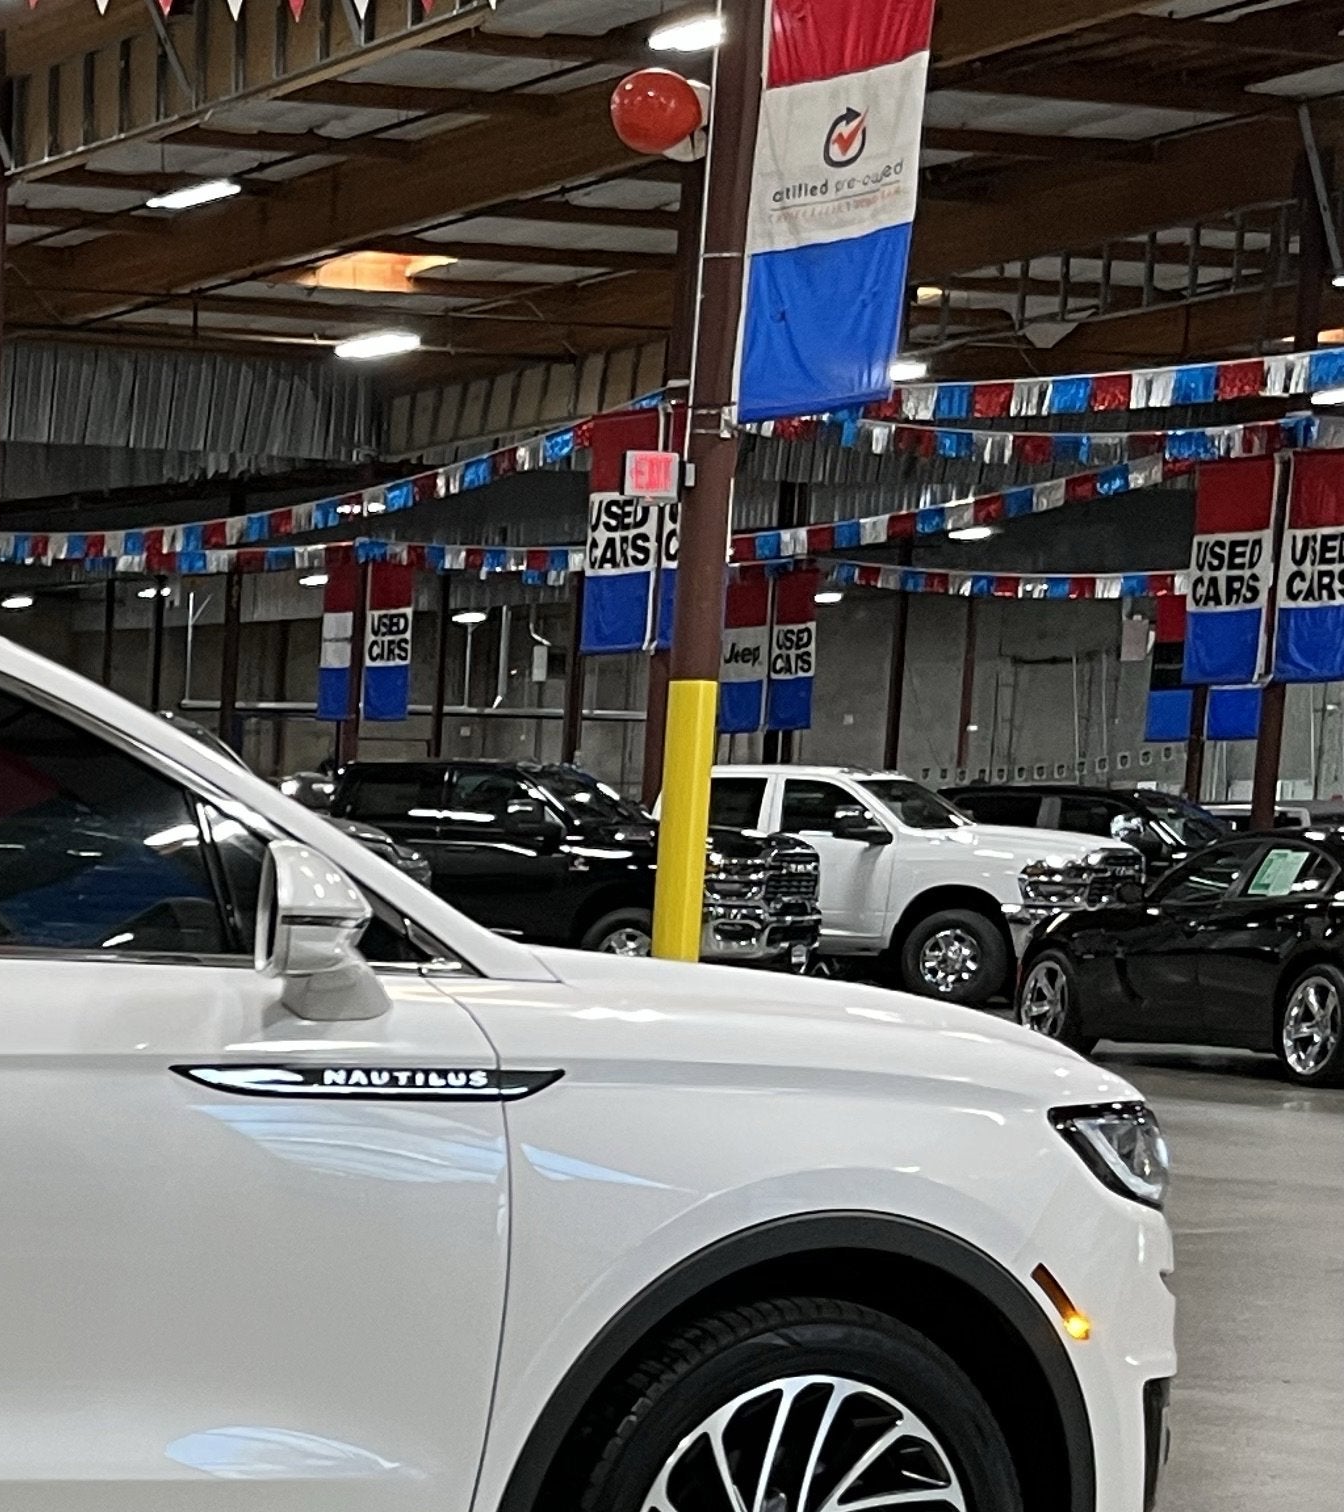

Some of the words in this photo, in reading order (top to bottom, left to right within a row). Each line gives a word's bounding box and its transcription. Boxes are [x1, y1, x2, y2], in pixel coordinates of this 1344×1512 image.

[634, 455, 673, 490] EXIT
[1196, 538, 1262, 572] USED
[1291, 532, 1344, 567] USE
[1192, 573, 1260, 606] CARS
[371, 613, 409, 636] USED
[322, 1068, 489, 1088] NAUTILUS
